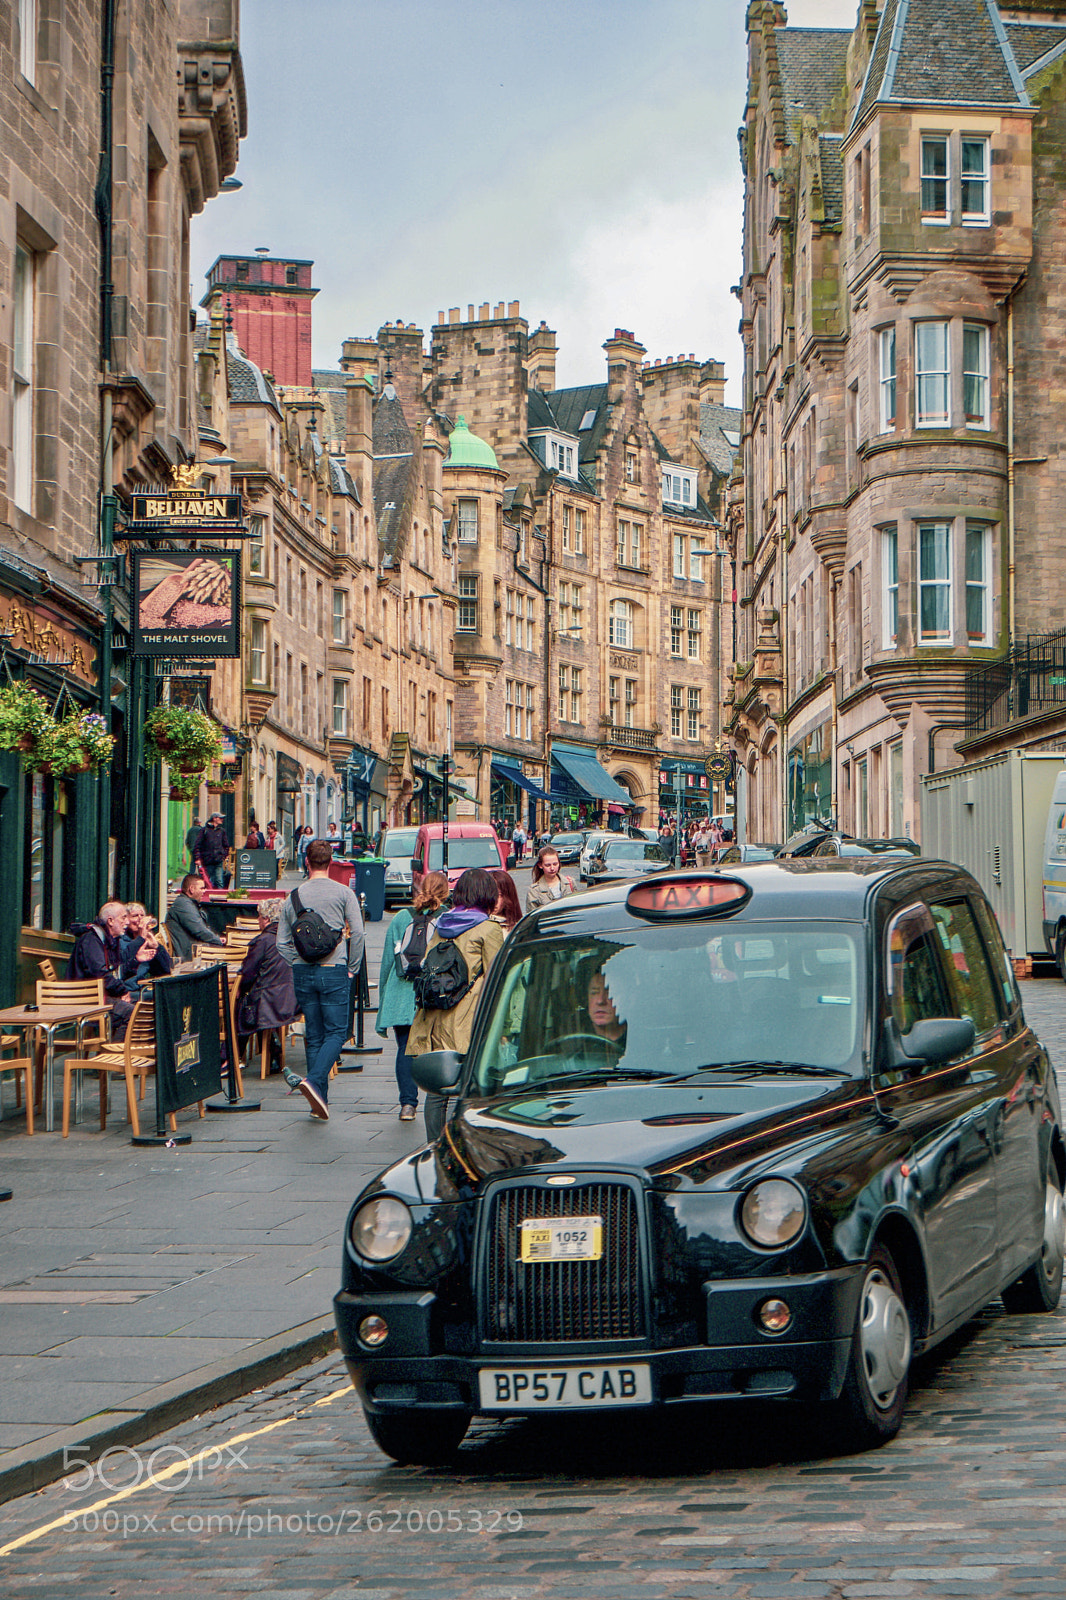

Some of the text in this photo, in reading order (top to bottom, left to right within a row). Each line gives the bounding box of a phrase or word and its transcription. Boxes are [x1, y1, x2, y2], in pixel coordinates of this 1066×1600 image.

[145, 499, 227, 518] BELHAVEN
[142, 635, 228, 643] THE MALT SHOVEL
[647, 884, 715, 908] TAXI
[555, 1231, 588, 1242] 1052
[494, 1369, 637, 1402] BP57 CAB
